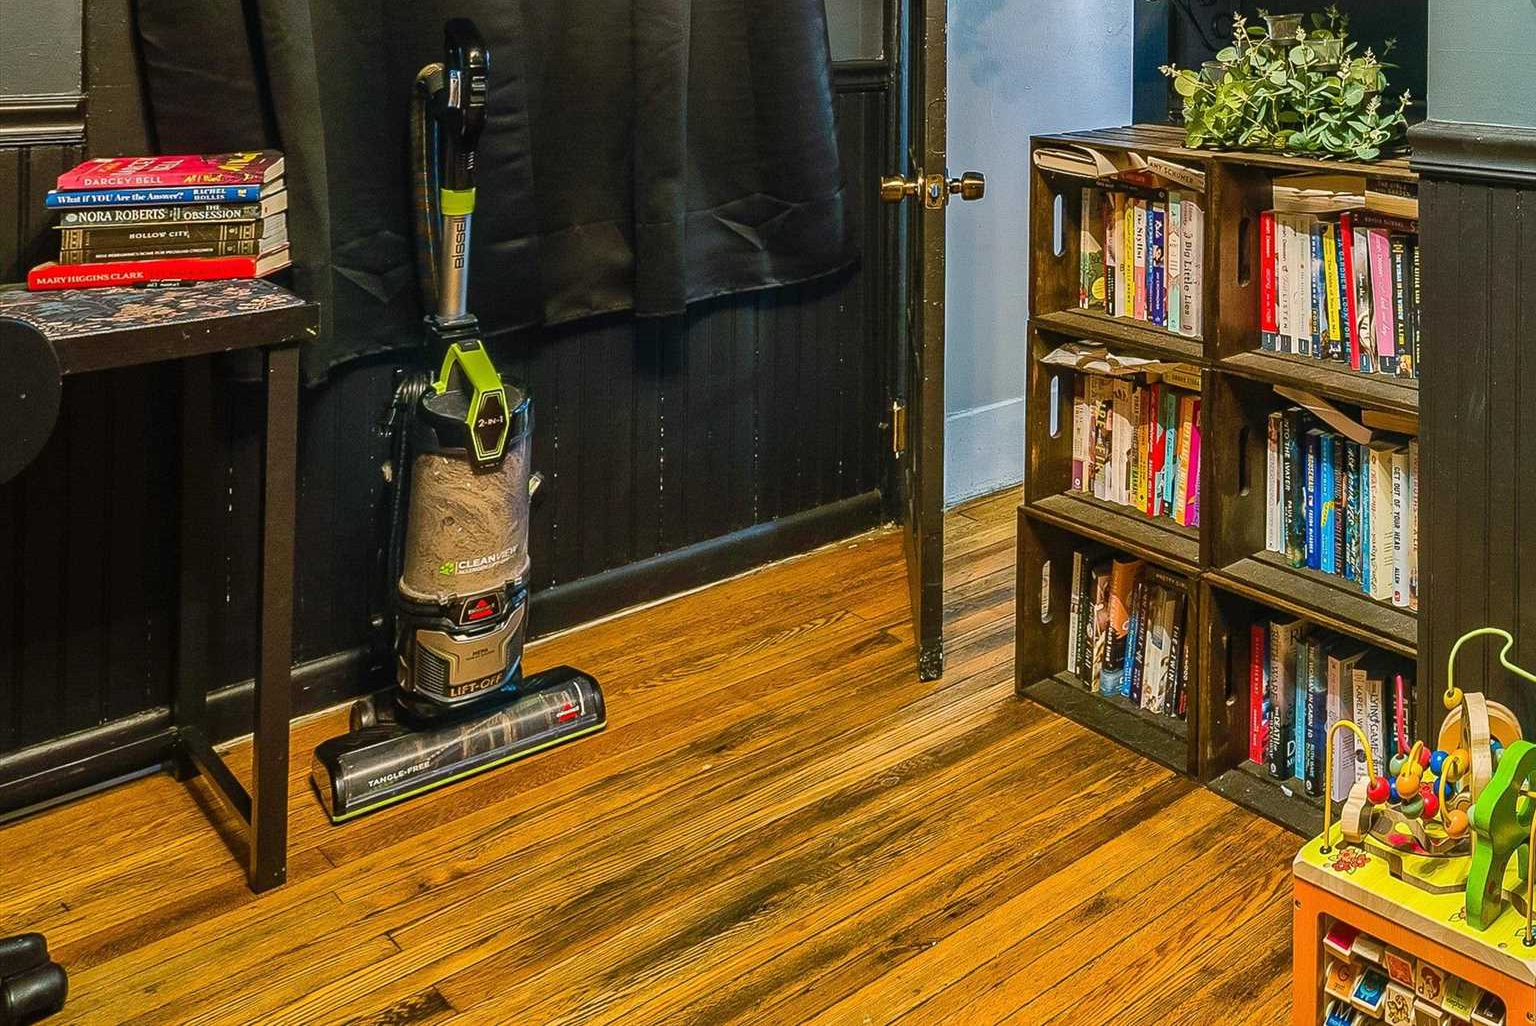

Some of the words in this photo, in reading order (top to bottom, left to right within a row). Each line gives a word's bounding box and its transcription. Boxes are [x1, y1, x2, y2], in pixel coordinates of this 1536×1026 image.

[84, 178, 133, 187] DARCEY
[135, 176, 164, 186] BELL
[57, 195, 79, 204] What
[91, 194, 113, 204] YOU
[114, 194, 130, 203] Are
[132, 193, 147, 202] the
[149, 192, 184, 202] Answer?
[78, 210, 112, 223] NORA
[115, 208, 165, 222] ROBERTS
[184, 208, 242, 221] OBSESSION
[129, 231, 167, 240] HOLLOW
[169, 230, 189, 239] CITY
[1136, 227, 1145, 261] Stylist
[1184, 242, 1193, 259] Big
[36, 276, 68, 286] MARY
[68, 274, 110, 284] HIGGINS
[110, 271, 144, 281] CLARK
[1184, 260, 1193, 292] Little
[1184, 294, 1192, 316] Lies
[1338, 251, 1347, 289] GARDNER
[1346, 342, 1351, 353] ME
[1394, 499, 1401, 508] OF
[1172, 626, 1180, 644] THE
[1168, 655, 1177, 681] TWIN
[1272, 666, 1280, 701] WARE
[1308, 694, 1315, 703] IN
[1356, 685, 1365, 715] KAREN
[1370, 694, 1380, 722] LYING
[1273, 716, 1281, 745] DEATH
[1307, 729, 1314, 738] 10
[1370, 724, 1379, 752] GAME
[368, 762, 431, 788] TANGLE-FREE
